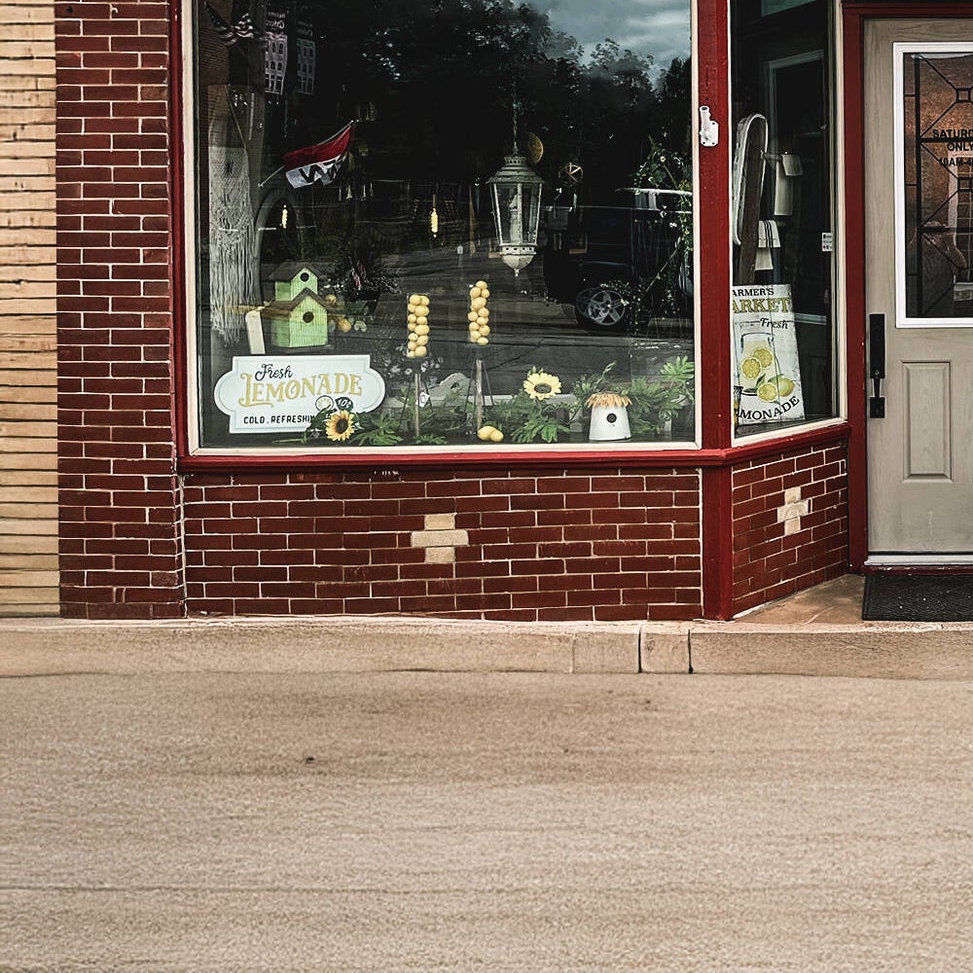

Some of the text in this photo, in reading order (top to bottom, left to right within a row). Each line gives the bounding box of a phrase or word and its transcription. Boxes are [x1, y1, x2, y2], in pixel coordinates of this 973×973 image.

[732, 288, 774, 296] ARMER'S
[732, 297, 790, 313] ARKET
[760, 318, 788, 329] Fresh
[255, 363, 293, 381] Fresh
[238, 372, 362, 408] LEMONADE
[738, 396, 800, 420] MONADE
[270, 414, 314, 423] REFRESHI
